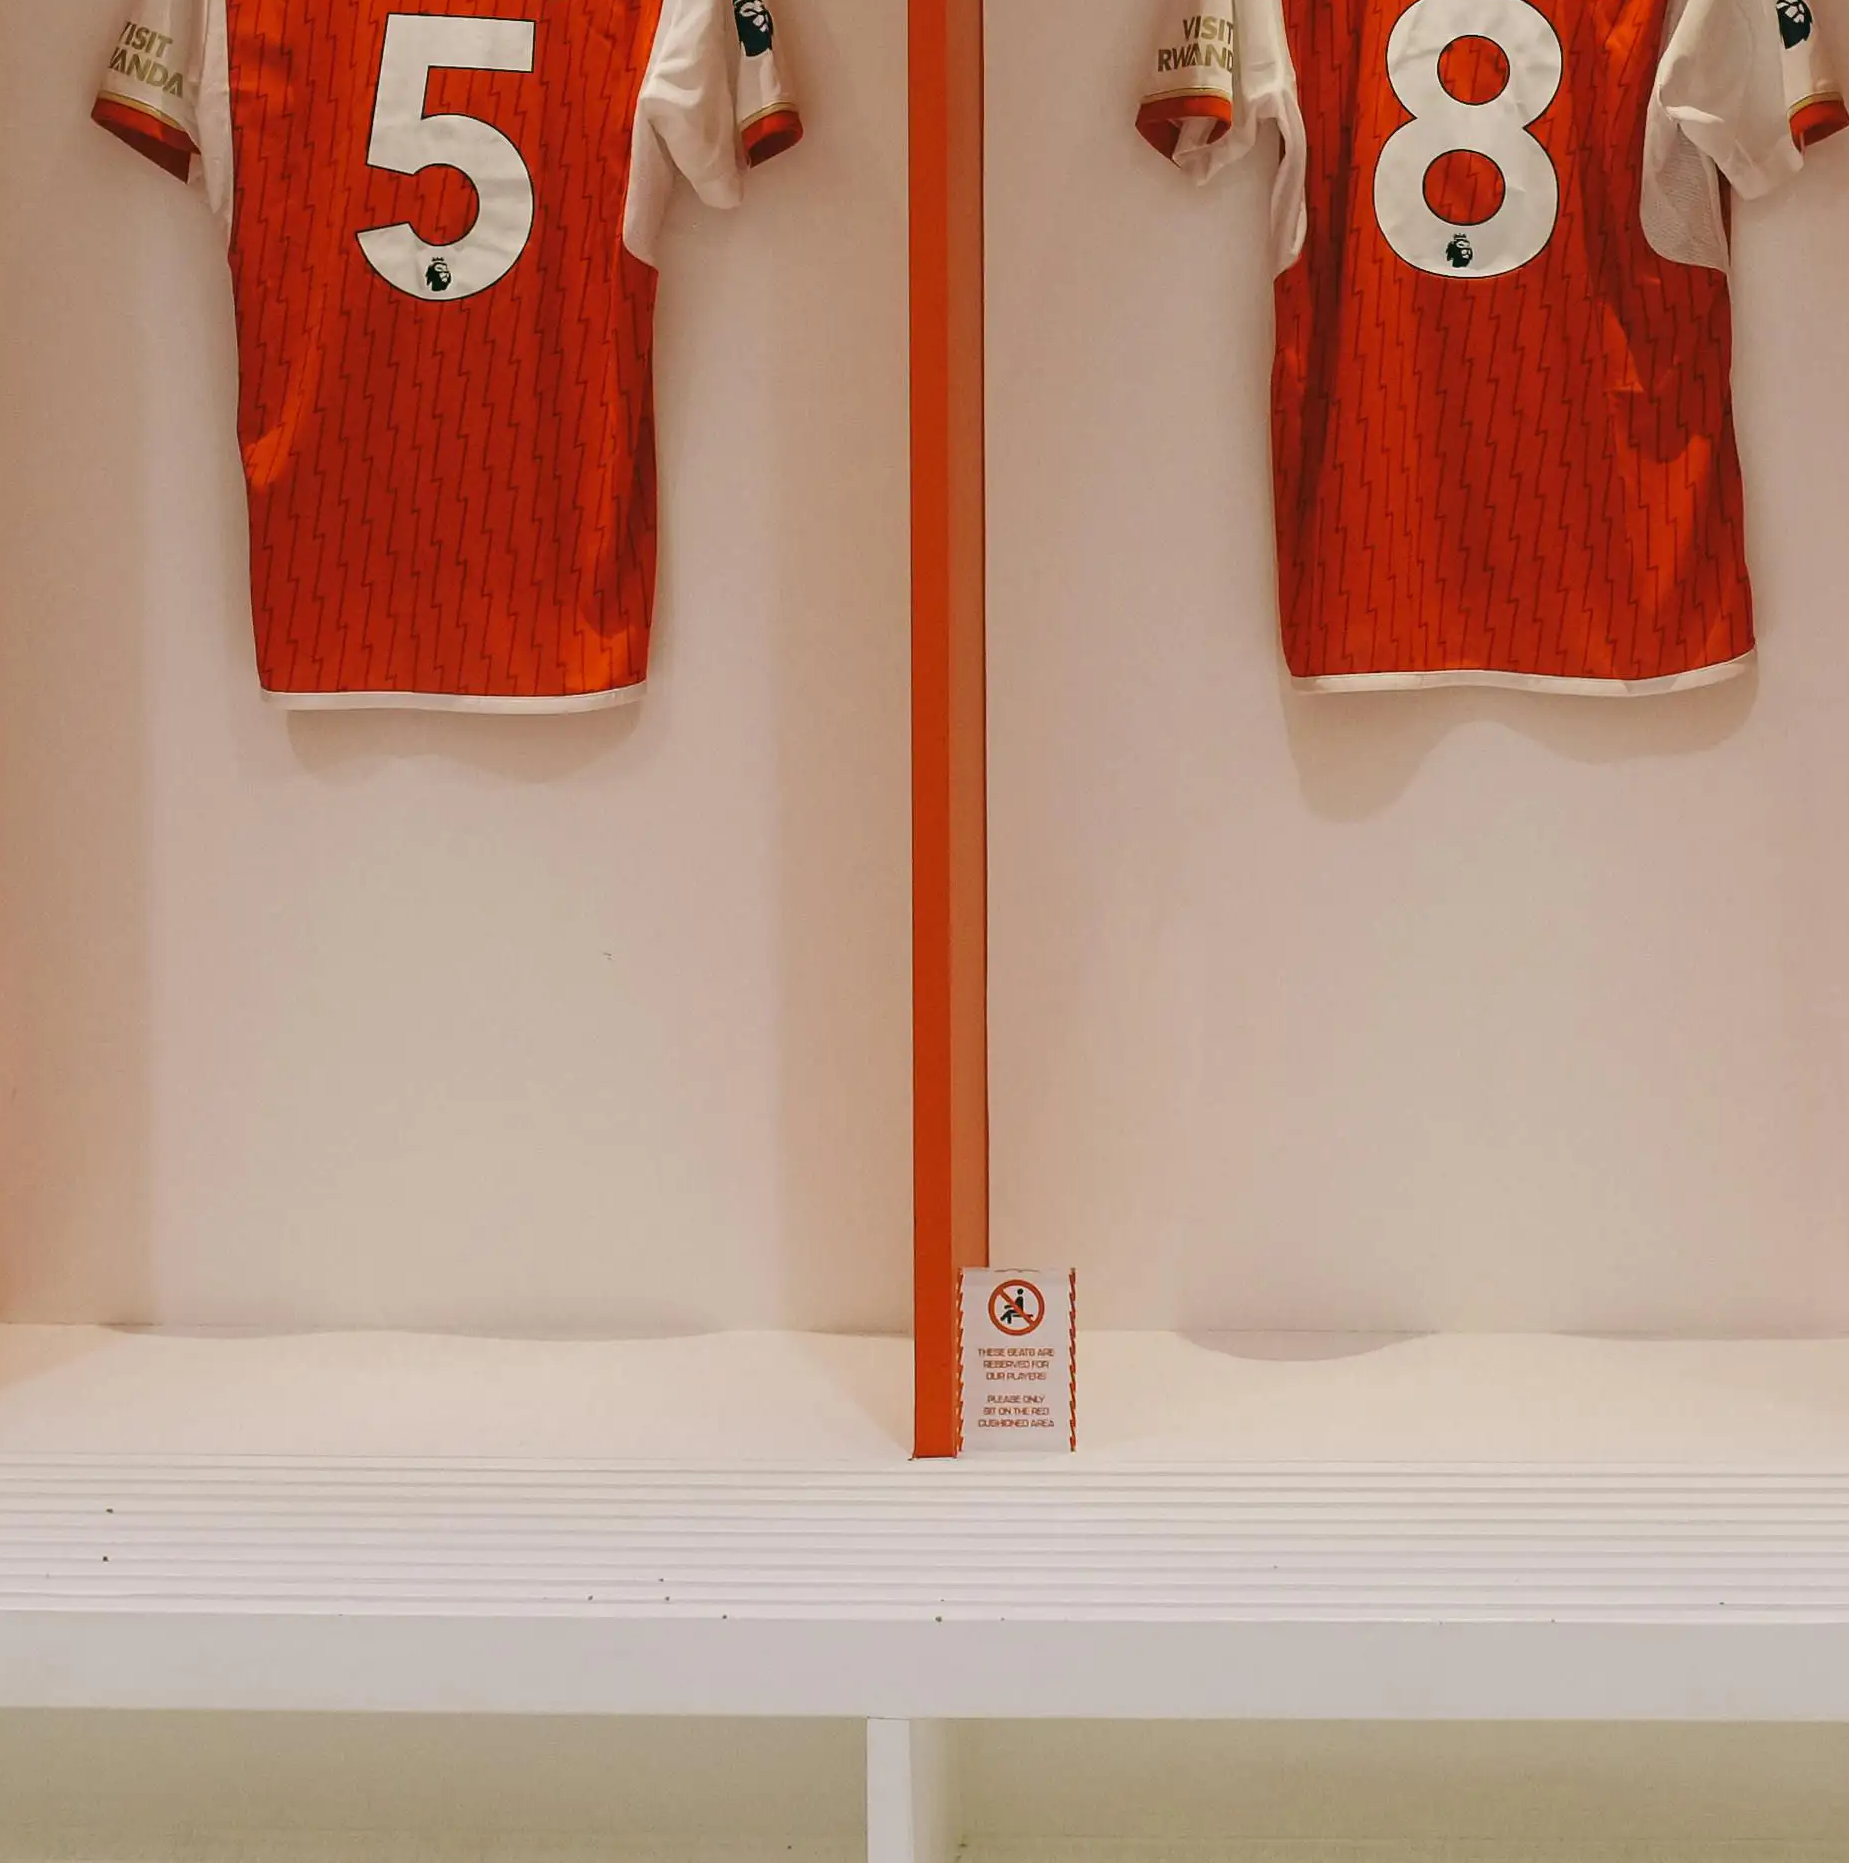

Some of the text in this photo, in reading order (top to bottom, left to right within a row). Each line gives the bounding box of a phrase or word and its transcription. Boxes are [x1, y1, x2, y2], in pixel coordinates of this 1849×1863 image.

[1182, 15, 1234, 46] VISIT
[109, 47, 184, 99] ANDA
[356, 13, 536, 301] 5
